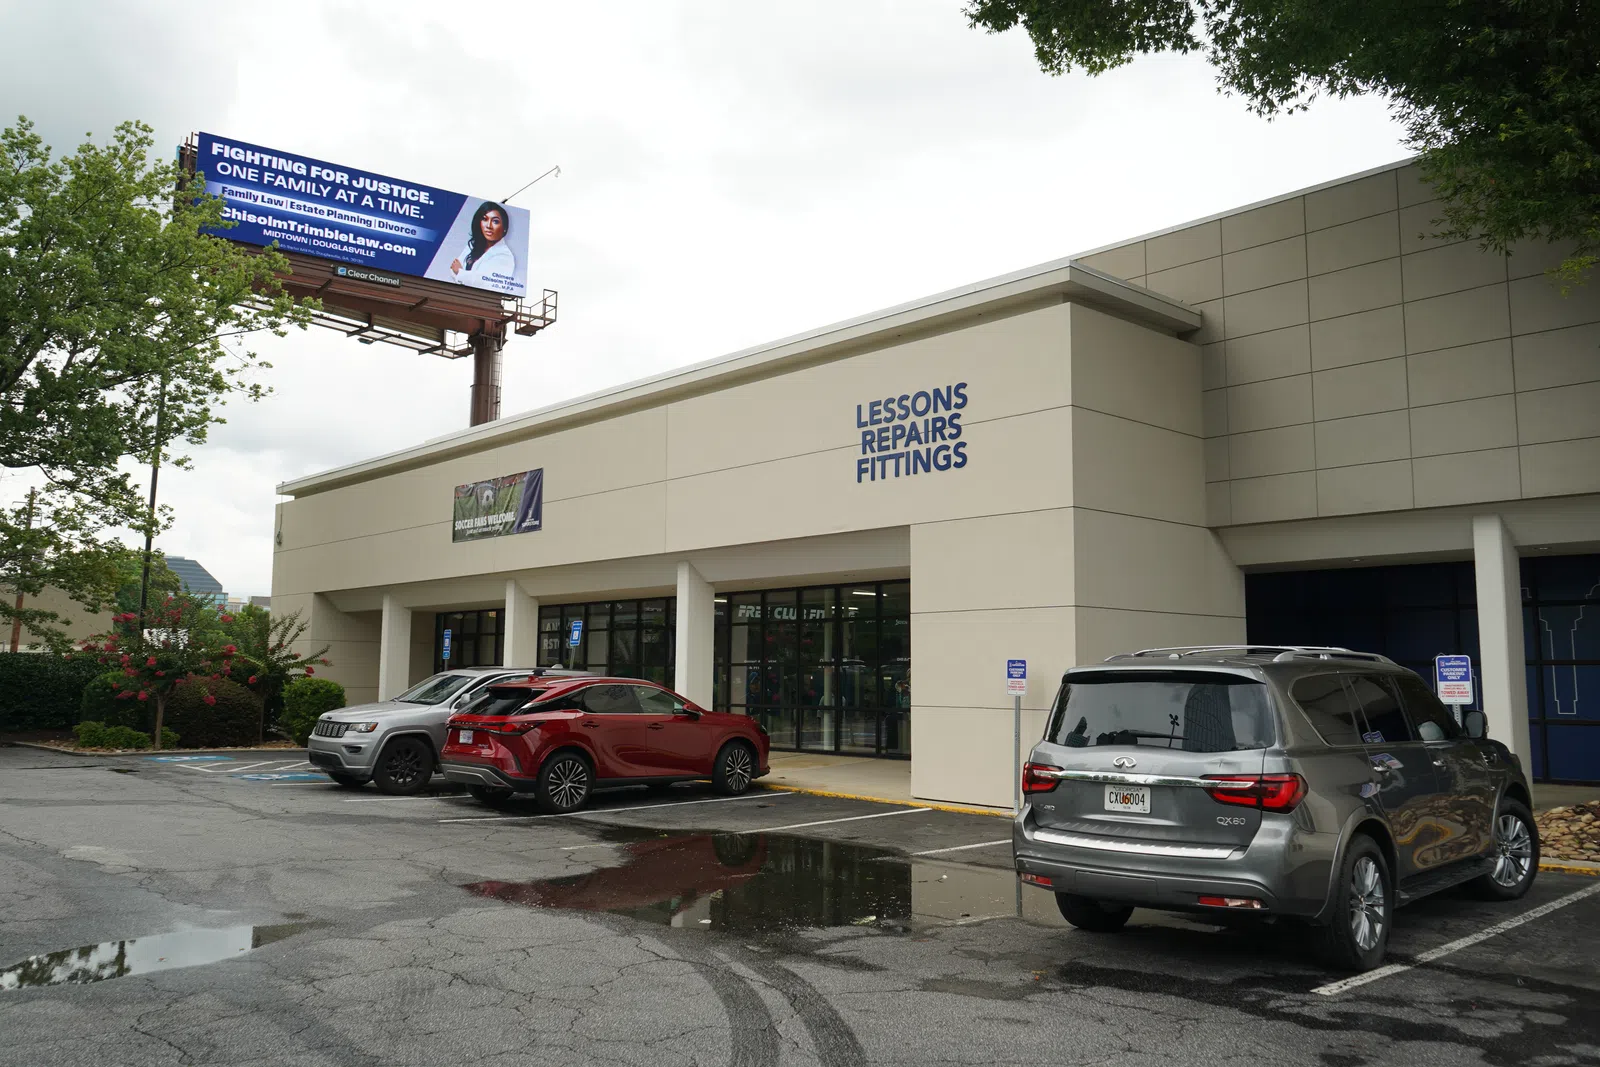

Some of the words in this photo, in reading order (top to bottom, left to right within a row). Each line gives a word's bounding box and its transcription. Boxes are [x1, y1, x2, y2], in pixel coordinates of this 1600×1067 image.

[211, 142, 307, 176] FIGHTING
[310, 165, 349, 186] FOR
[352, 177, 434, 206] JUSTICE.
[216, 161, 259, 182] ONE
[263, 172, 331, 198] FAMILY
[334, 188, 358, 204] AT
[361, 194, 374, 208] A
[377, 197, 425, 220] TIME.
[220, 206, 416, 256] ChisolmTrimbleLaw.com
[221, 186, 259, 203] Family
[261, 193, 284, 207] Law
[290, 201, 325, 216] Estate
[327, 210, 372, 228] Planning
[378, 220, 417, 236] Divorce
[262, 228, 308, 245] MIDTOWN
[312, 239, 376, 258] DOUGLASVILLE
[347, 269, 368, 280] Clear
[368, 273, 400, 285] Channel
[856, 381, 968, 428] LESSONS
[861, 412, 962, 455] REPAIRS
[857, 441, 968, 483] FITTINGS
[455, 518, 473, 530] SOCCER
[474, 516, 487, 527] FANS
[1216, 816, 1246, 826] QX80
